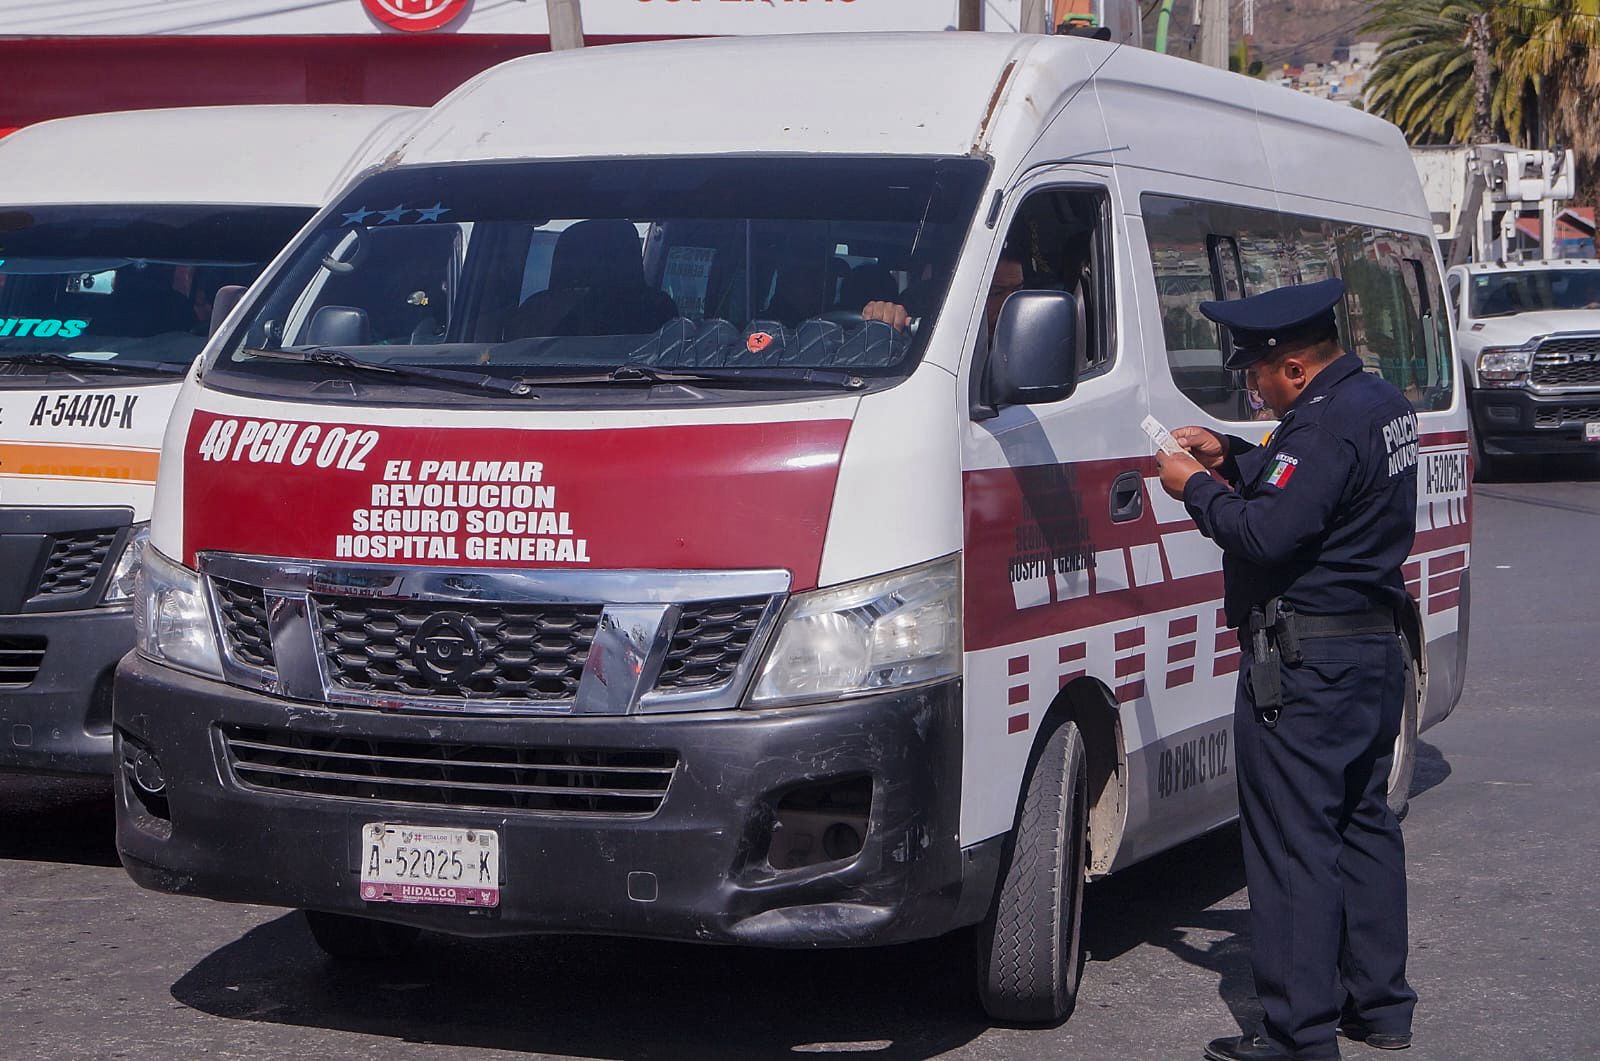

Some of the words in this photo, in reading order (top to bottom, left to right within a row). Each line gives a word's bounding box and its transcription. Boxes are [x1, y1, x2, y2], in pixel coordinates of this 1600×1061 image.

[0, 319, 88, 338] ITOS
[30, 395, 138, 429] A-54470-K
[199, 419, 238, 461] 48
[232, 421, 298, 463] PCH
[290, 424, 321, 466] C
[316, 427, 379, 471] 012
[383, 460, 412, 481] EL
[418, 461, 544, 482] PALMAR
[1426, 453, 1466, 494] A-52025-K
[371, 484, 555, 508] REVOLUCION
[353, 509, 459, 533] SEGURO
[466, 511, 574, 535] SOCIAL
[336, 535, 459, 559] HOSPITAL
[465, 537, 591, 562] GENERAL
[1158, 749, 1173, 799] 48
[1199, 735, 1206, 783] C
[1208, 729, 1228, 780] 012
[368, 844, 491, 883] A-52025-K
[402, 885, 456, 898] HIDALGO
